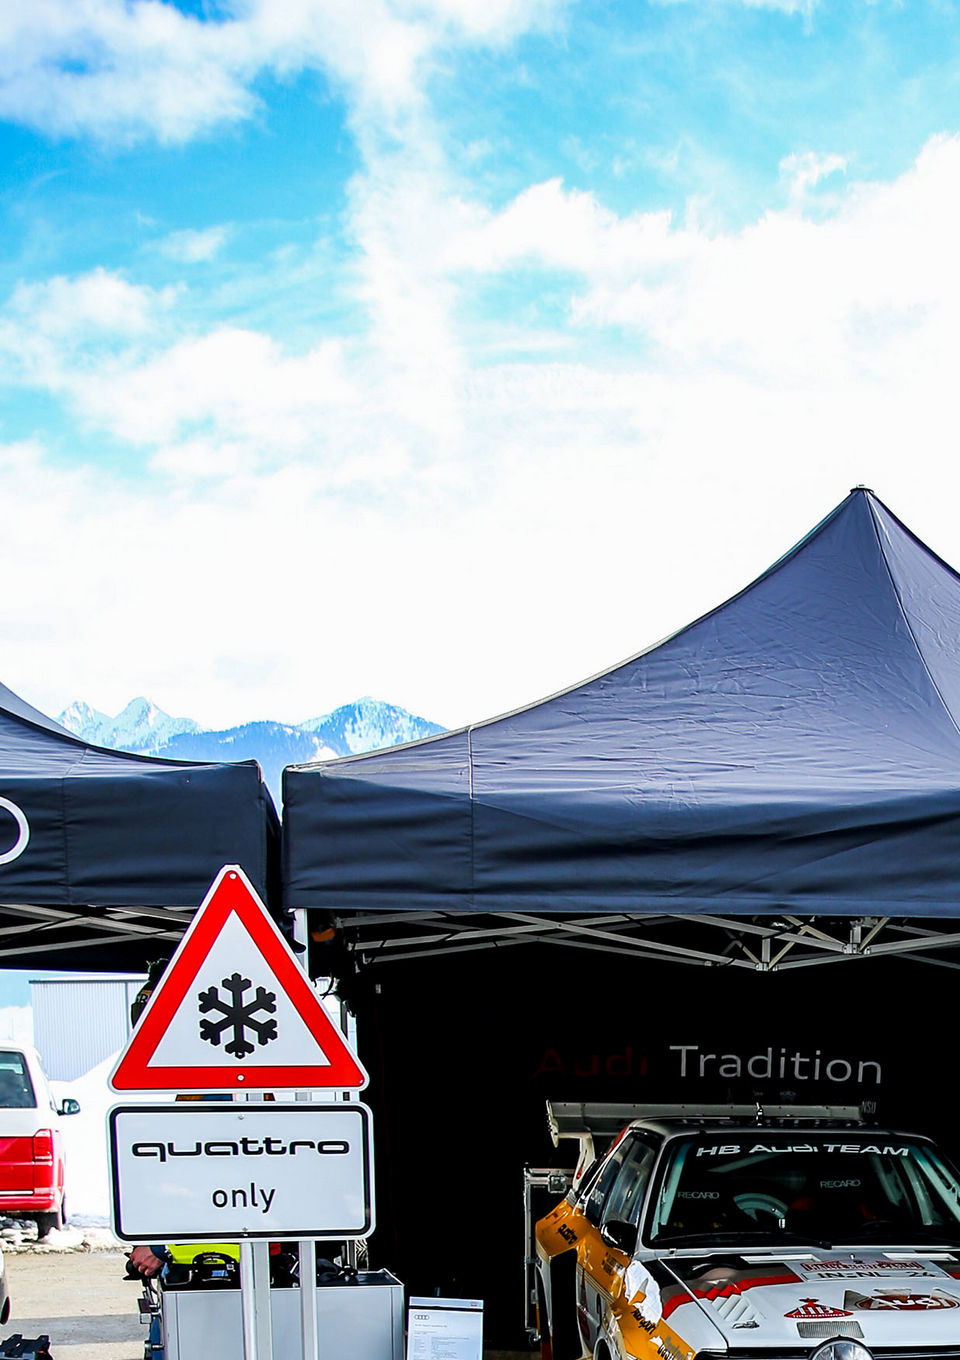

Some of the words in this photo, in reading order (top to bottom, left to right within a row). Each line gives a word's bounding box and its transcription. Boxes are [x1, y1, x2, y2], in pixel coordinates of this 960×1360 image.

[533, 1047, 648, 1078] Audi
[669, 1045, 882, 1084] Tradition
[132, 1137, 351, 1163] quattro
[696, 1145, 741, 1157] HB
[749, 1144, 818, 1153] Audi
[823, 1144, 908, 1157] TEAM
[821, 1179, 861, 1189] RECARO
[212, 1182, 275, 1213] only
[678, 1191, 720, 1200] RECARO
